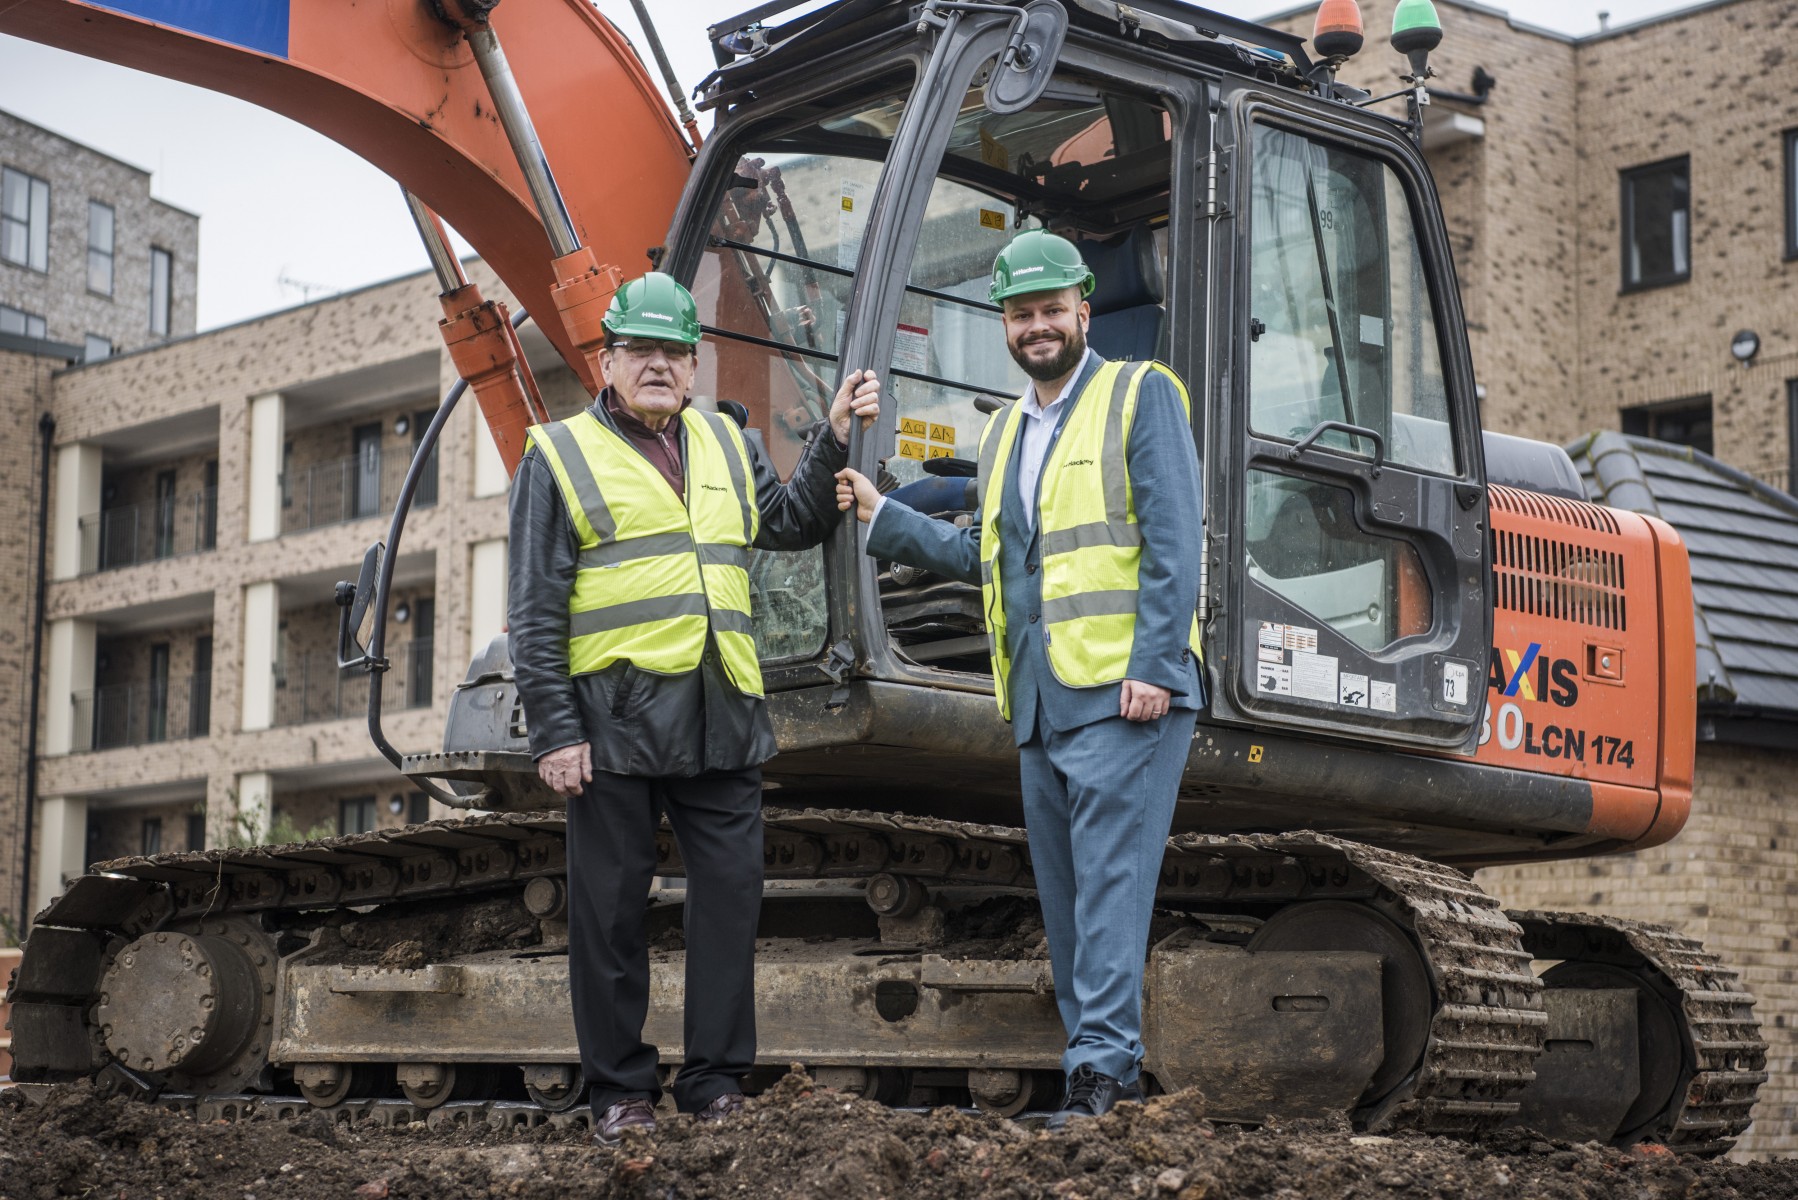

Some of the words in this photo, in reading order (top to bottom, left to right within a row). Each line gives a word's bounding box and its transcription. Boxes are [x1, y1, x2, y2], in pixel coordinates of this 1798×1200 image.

[1320, 210, 1333, 230] 99
[1445, 678, 1455, 698] 73
[1591, 735, 1635, 769] 174
